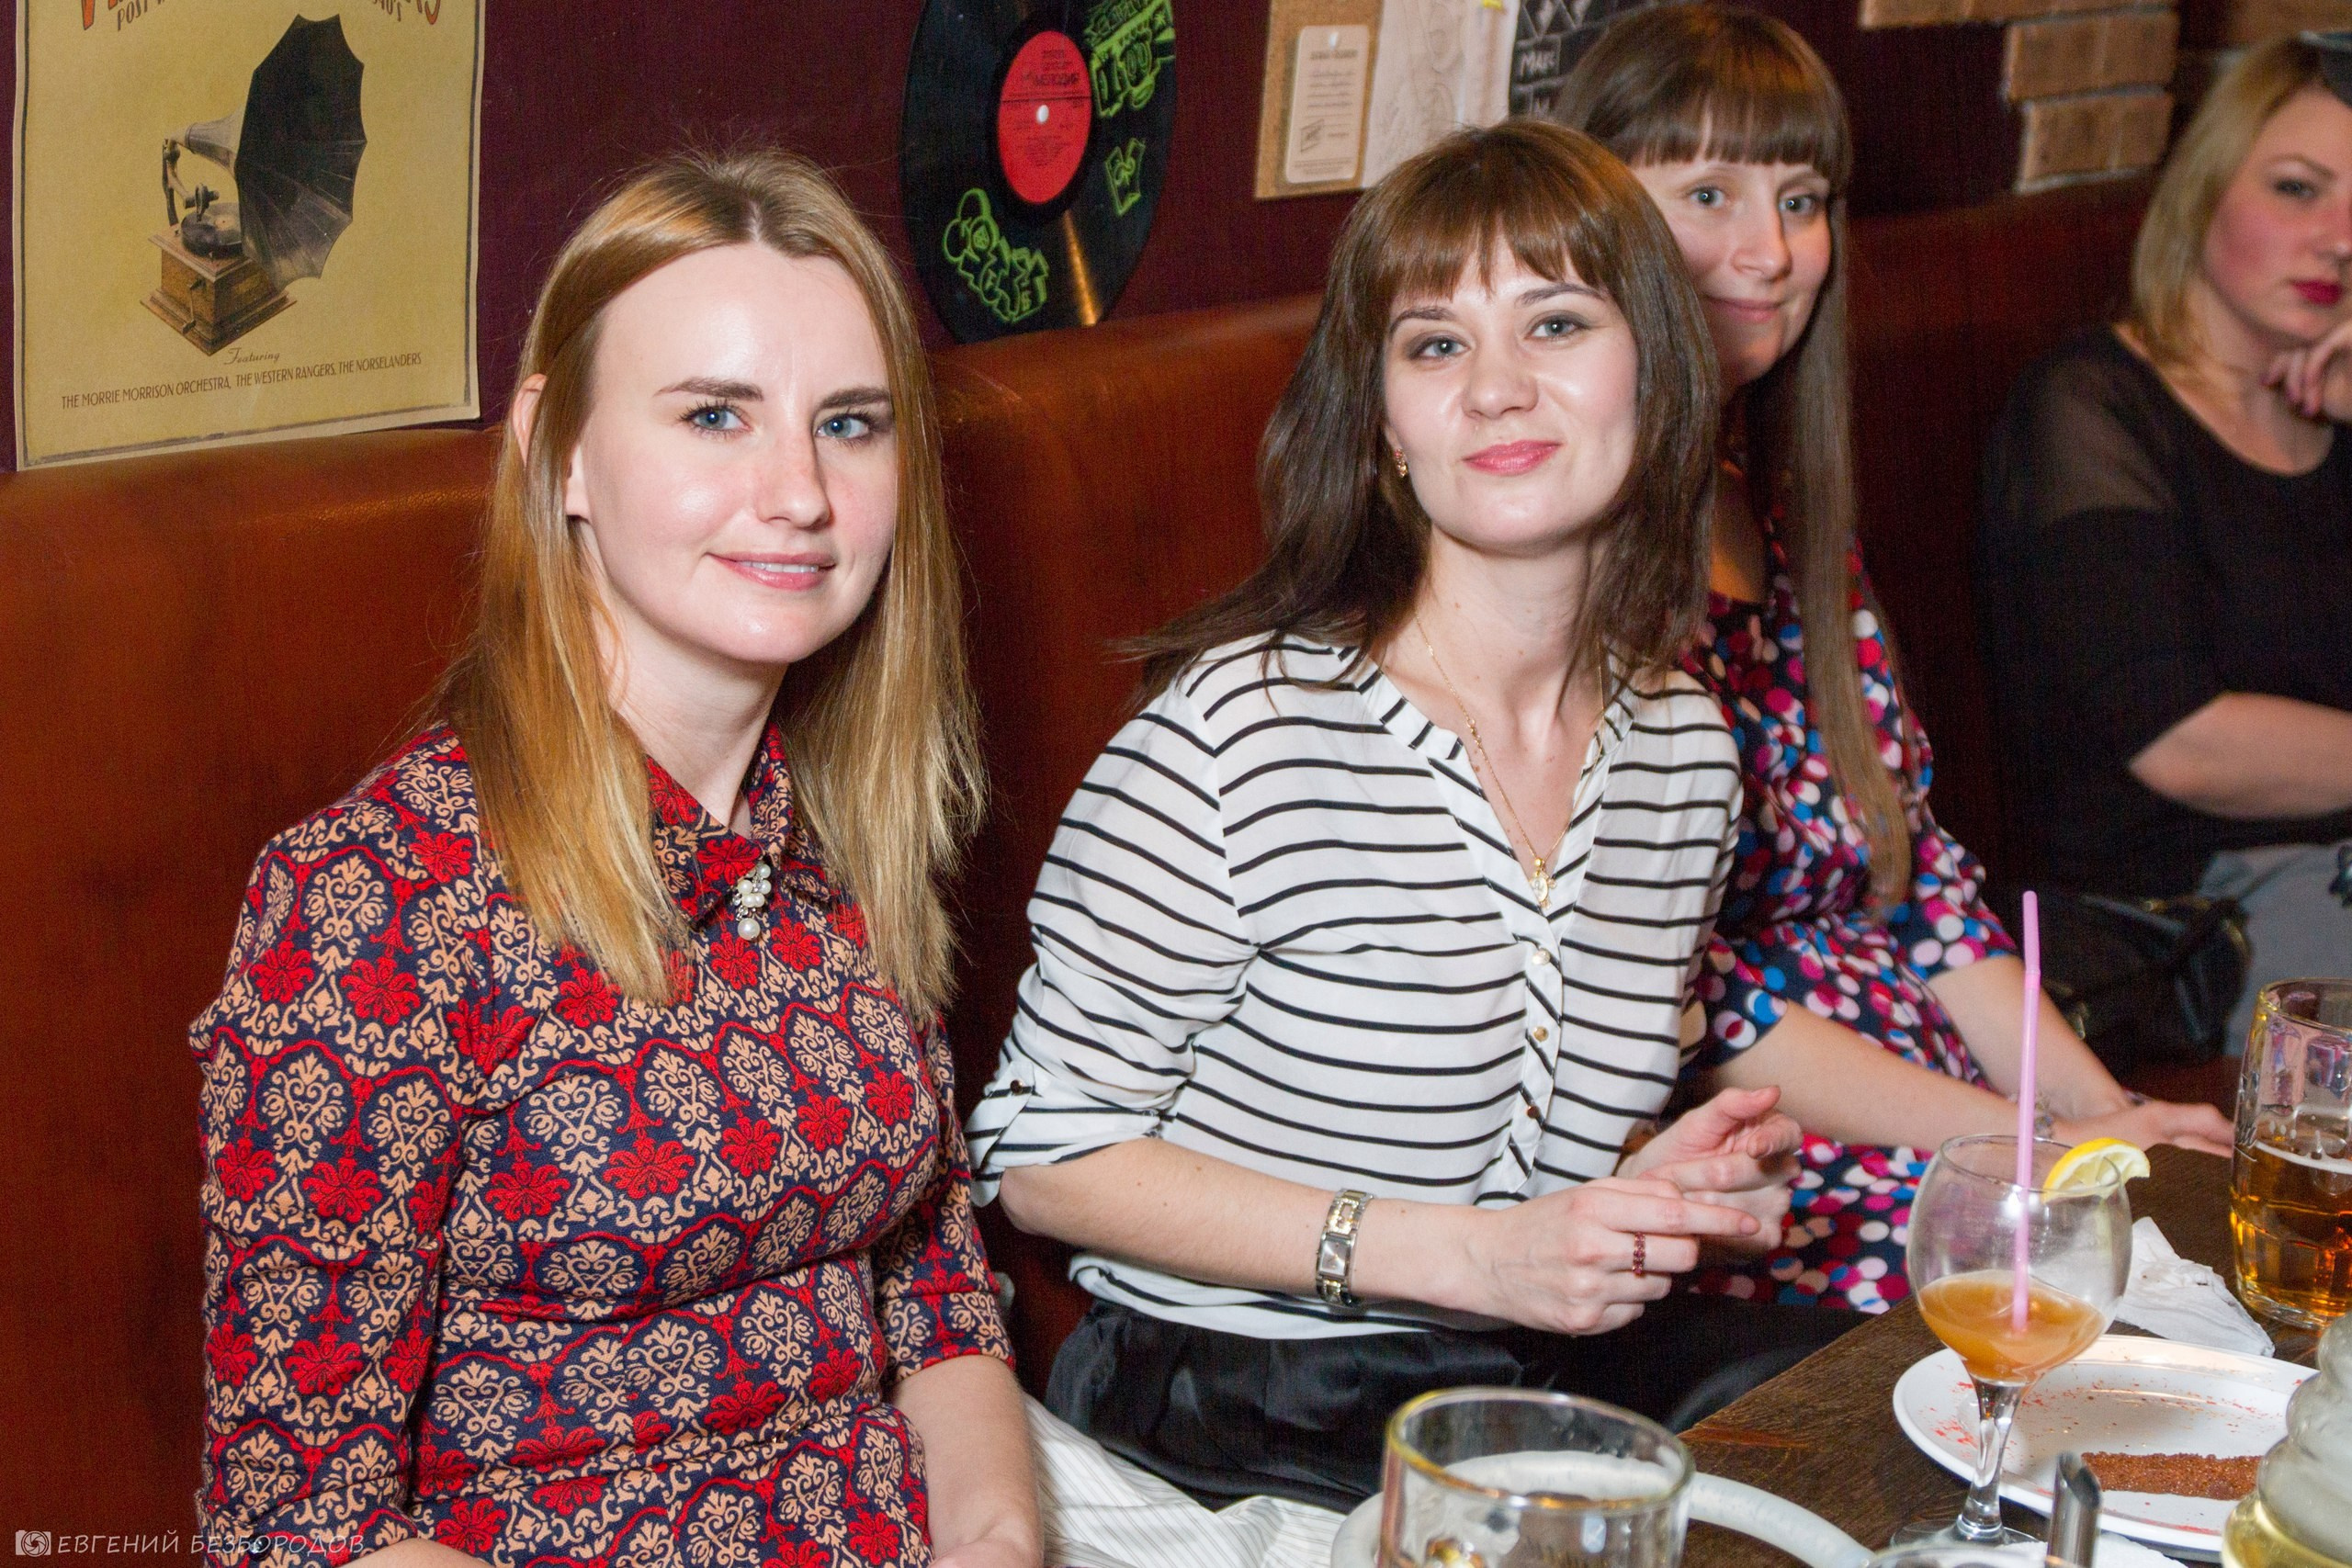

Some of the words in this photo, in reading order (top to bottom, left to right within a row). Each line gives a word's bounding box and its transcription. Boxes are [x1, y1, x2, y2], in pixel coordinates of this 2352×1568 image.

[223, 346, 281, 366] Featuring
[62, 395, 79, 410] THE
[82, 389, 120, 407] MORRIE
[122, 384, 175, 401] MORRISON
[175, 376, 232, 396] ORCHESTRA,
[236, 374, 253, 388] THE
[254, 368, 294, 385] WESTERN
[338, 361, 355, 375] THE
[356, 352, 423, 372] NORSELANDERS
